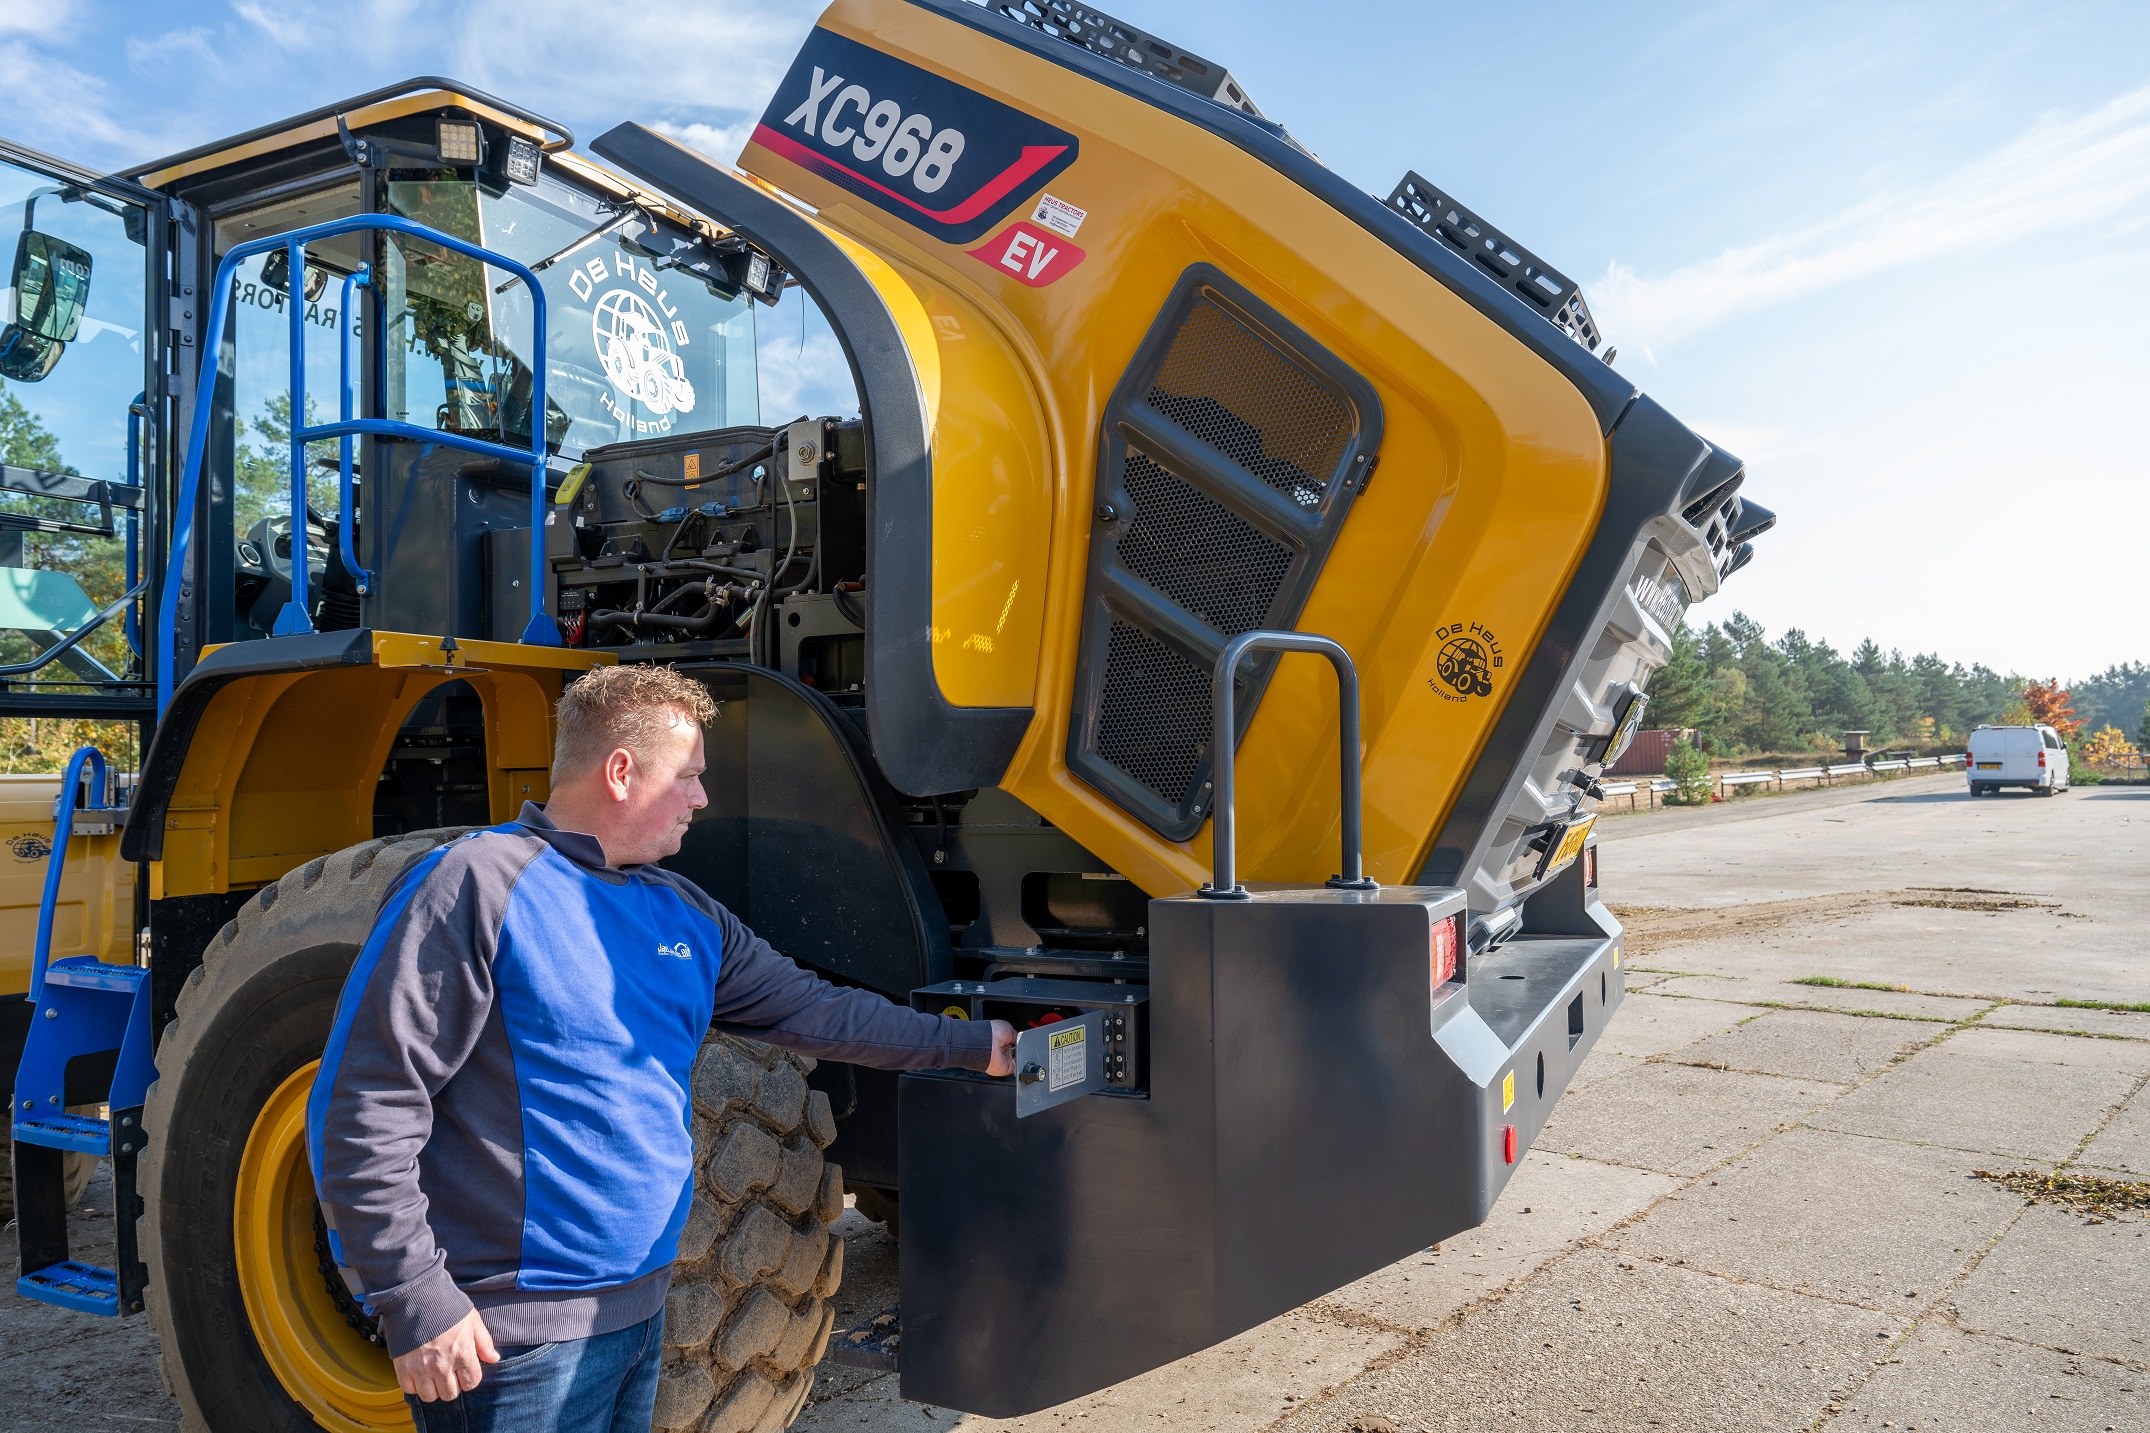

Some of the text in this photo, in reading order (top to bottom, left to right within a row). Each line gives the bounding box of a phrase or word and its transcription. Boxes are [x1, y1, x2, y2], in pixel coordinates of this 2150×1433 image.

[784, 66, 965, 193] XC968
[1044, 196, 1059, 207] HEUS
[1058, 202, 1085, 218] TRACTORS
[1001, 231, 1058, 280] EV
[599, 391, 671, 434] Holland
[1427, 678, 1467, 702] Holland
[1060, 1030, 1081, 1046] CAUTION
